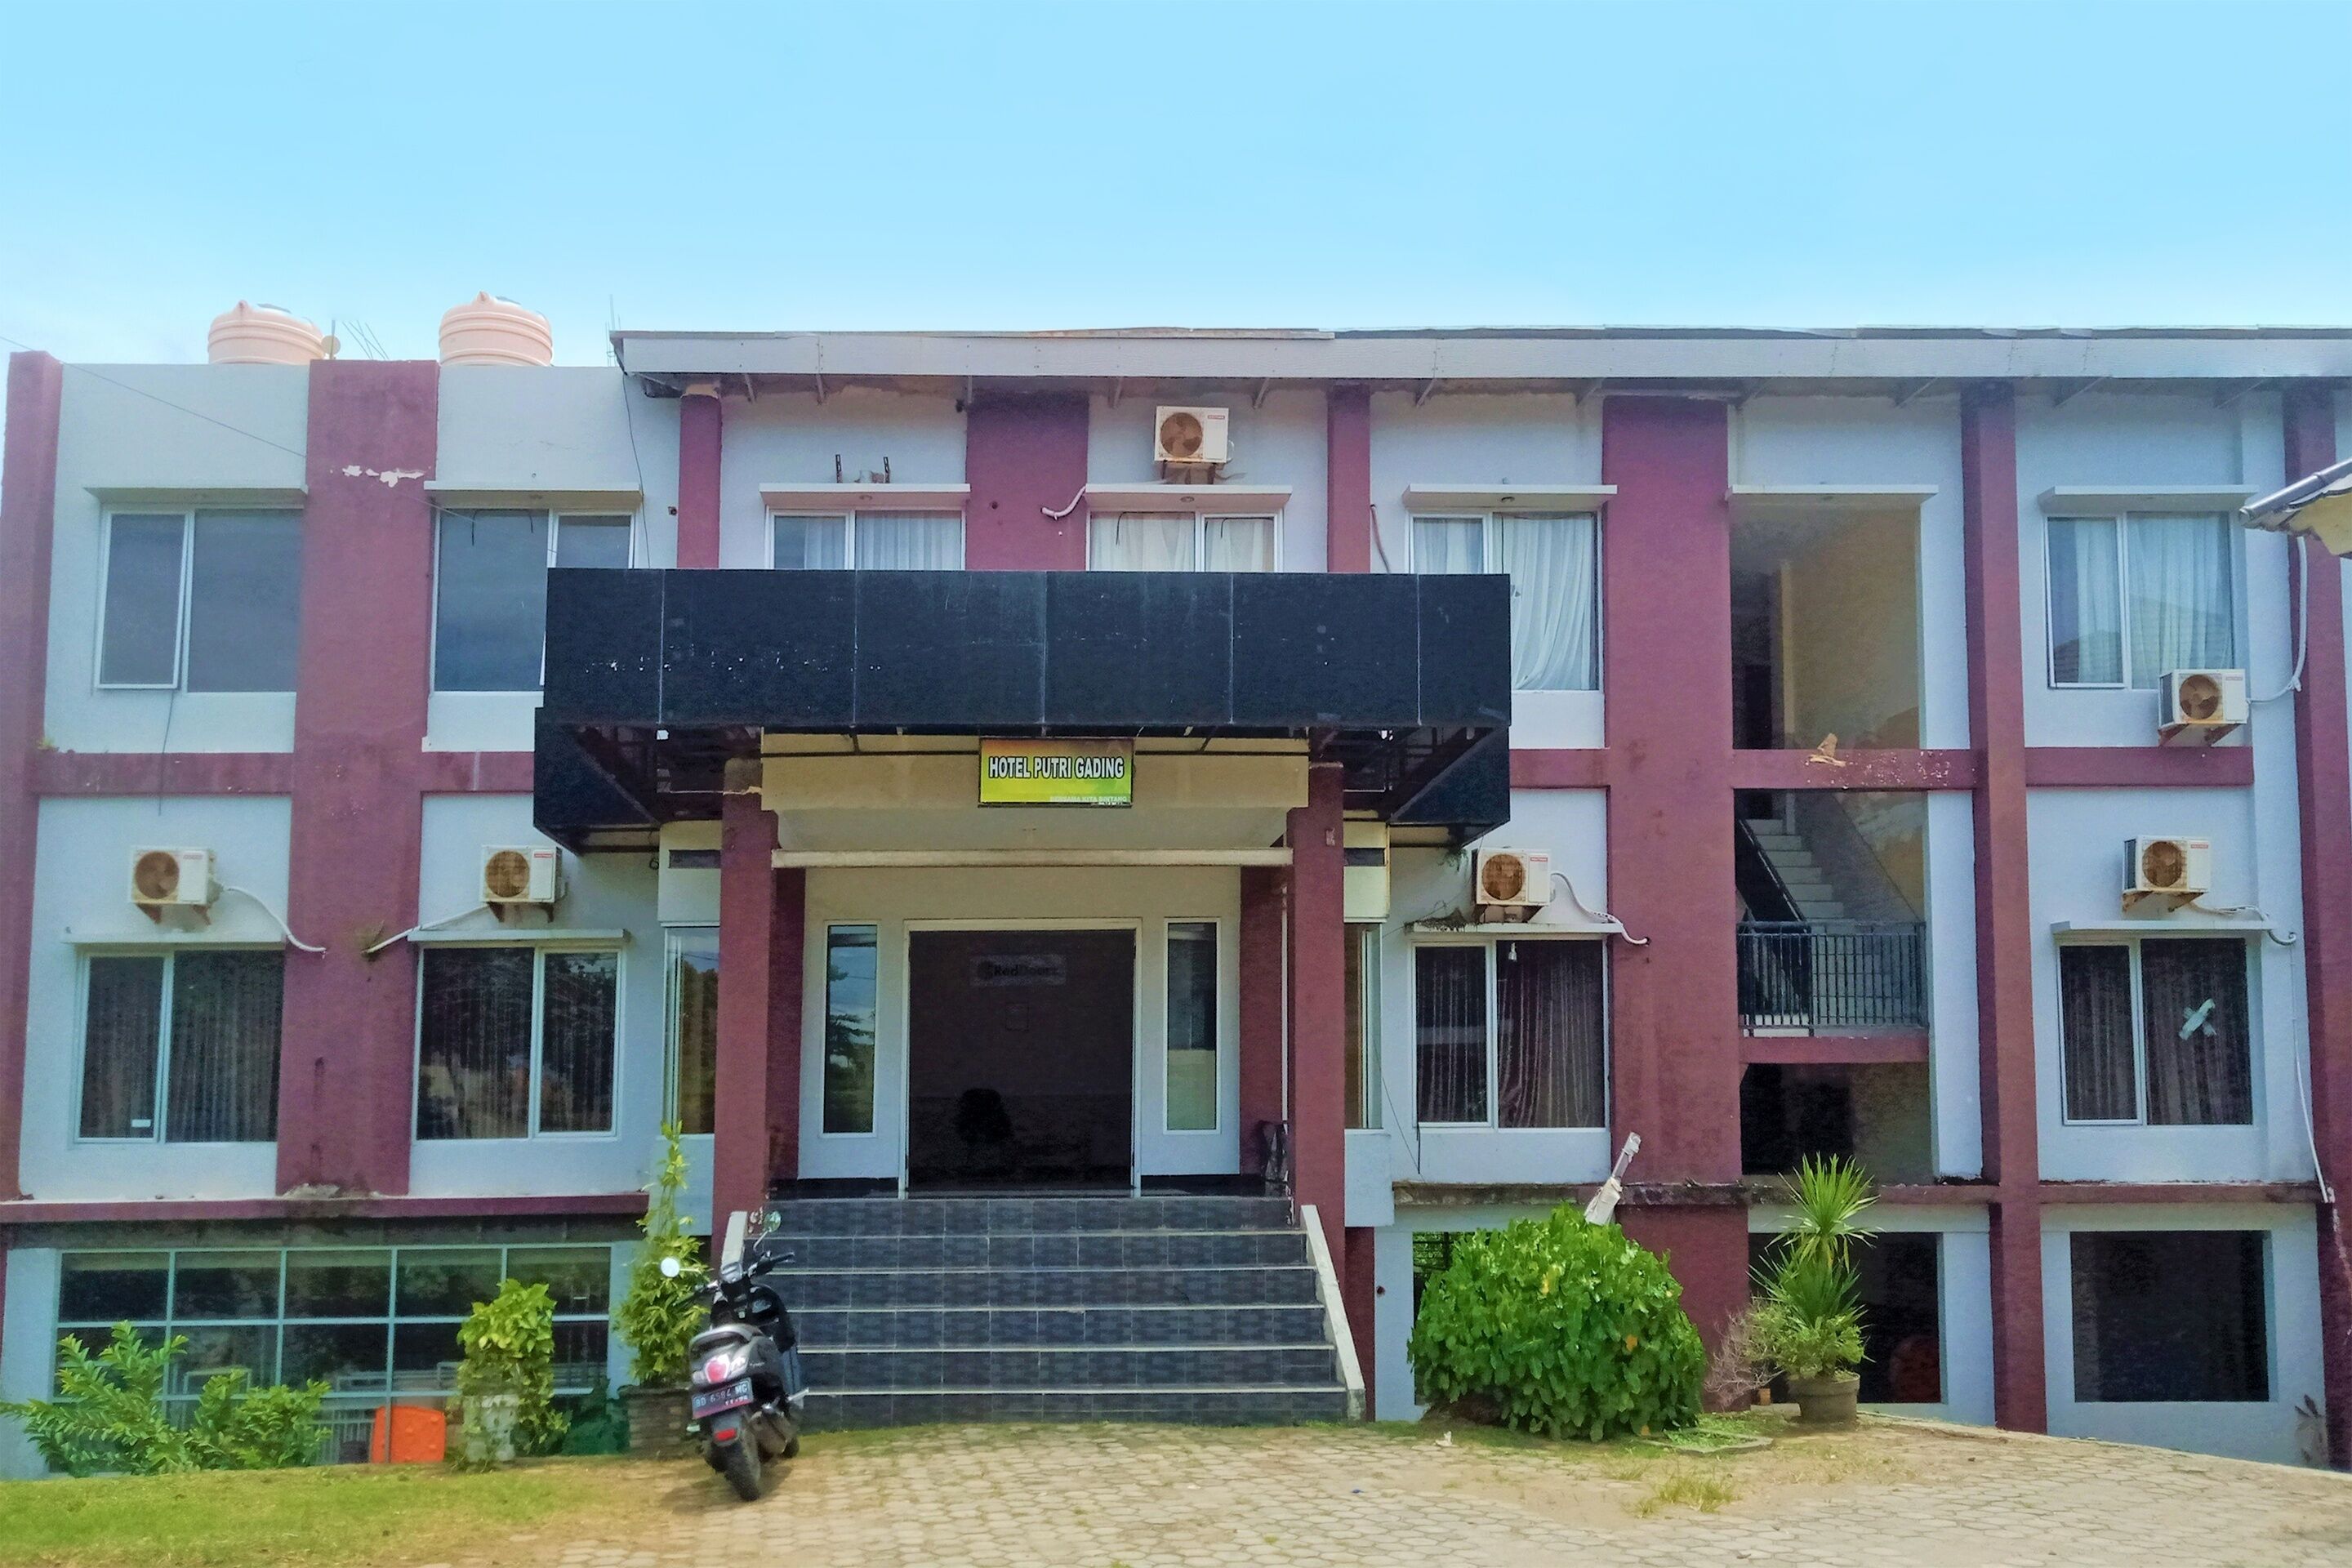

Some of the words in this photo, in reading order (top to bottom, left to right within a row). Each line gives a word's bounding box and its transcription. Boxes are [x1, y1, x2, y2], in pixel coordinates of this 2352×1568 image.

[989, 756, 1031, 778] HOTEL
[1034, 756, 1072, 778] PUTRI
[1075, 756, 1125, 778] GADING
